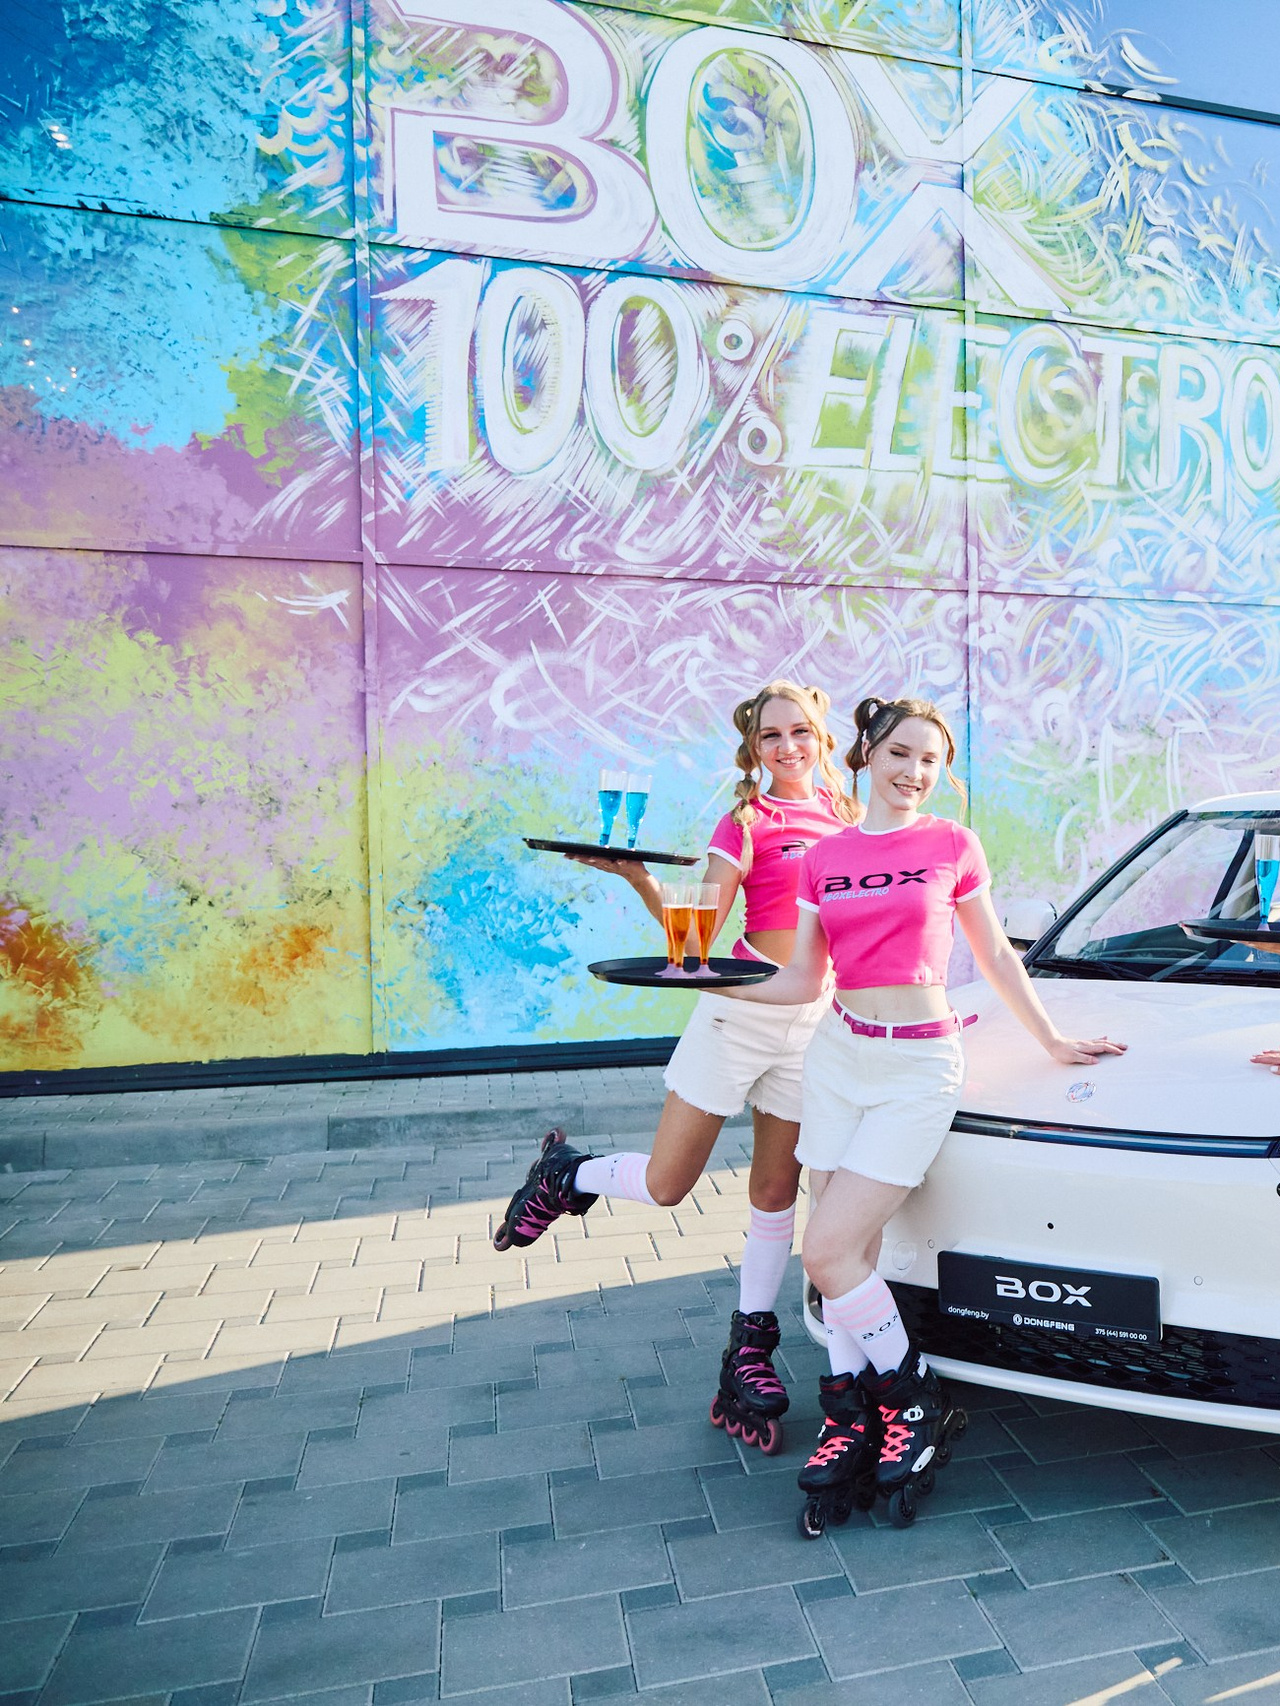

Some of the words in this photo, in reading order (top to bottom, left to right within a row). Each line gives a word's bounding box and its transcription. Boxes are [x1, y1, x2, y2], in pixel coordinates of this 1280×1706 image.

[380, 0, 1074, 312] BOX
[368, 260, 795, 476] 100%
[824, 868, 927, 893] BOX
[995, 1276, 1092, 1307] BOX
[948, 1306, 990, 1320] dongfeng.by
[1024, 1317, 1075, 1331] DONGFENG
[1138, 1333, 1147, 1341] 00
